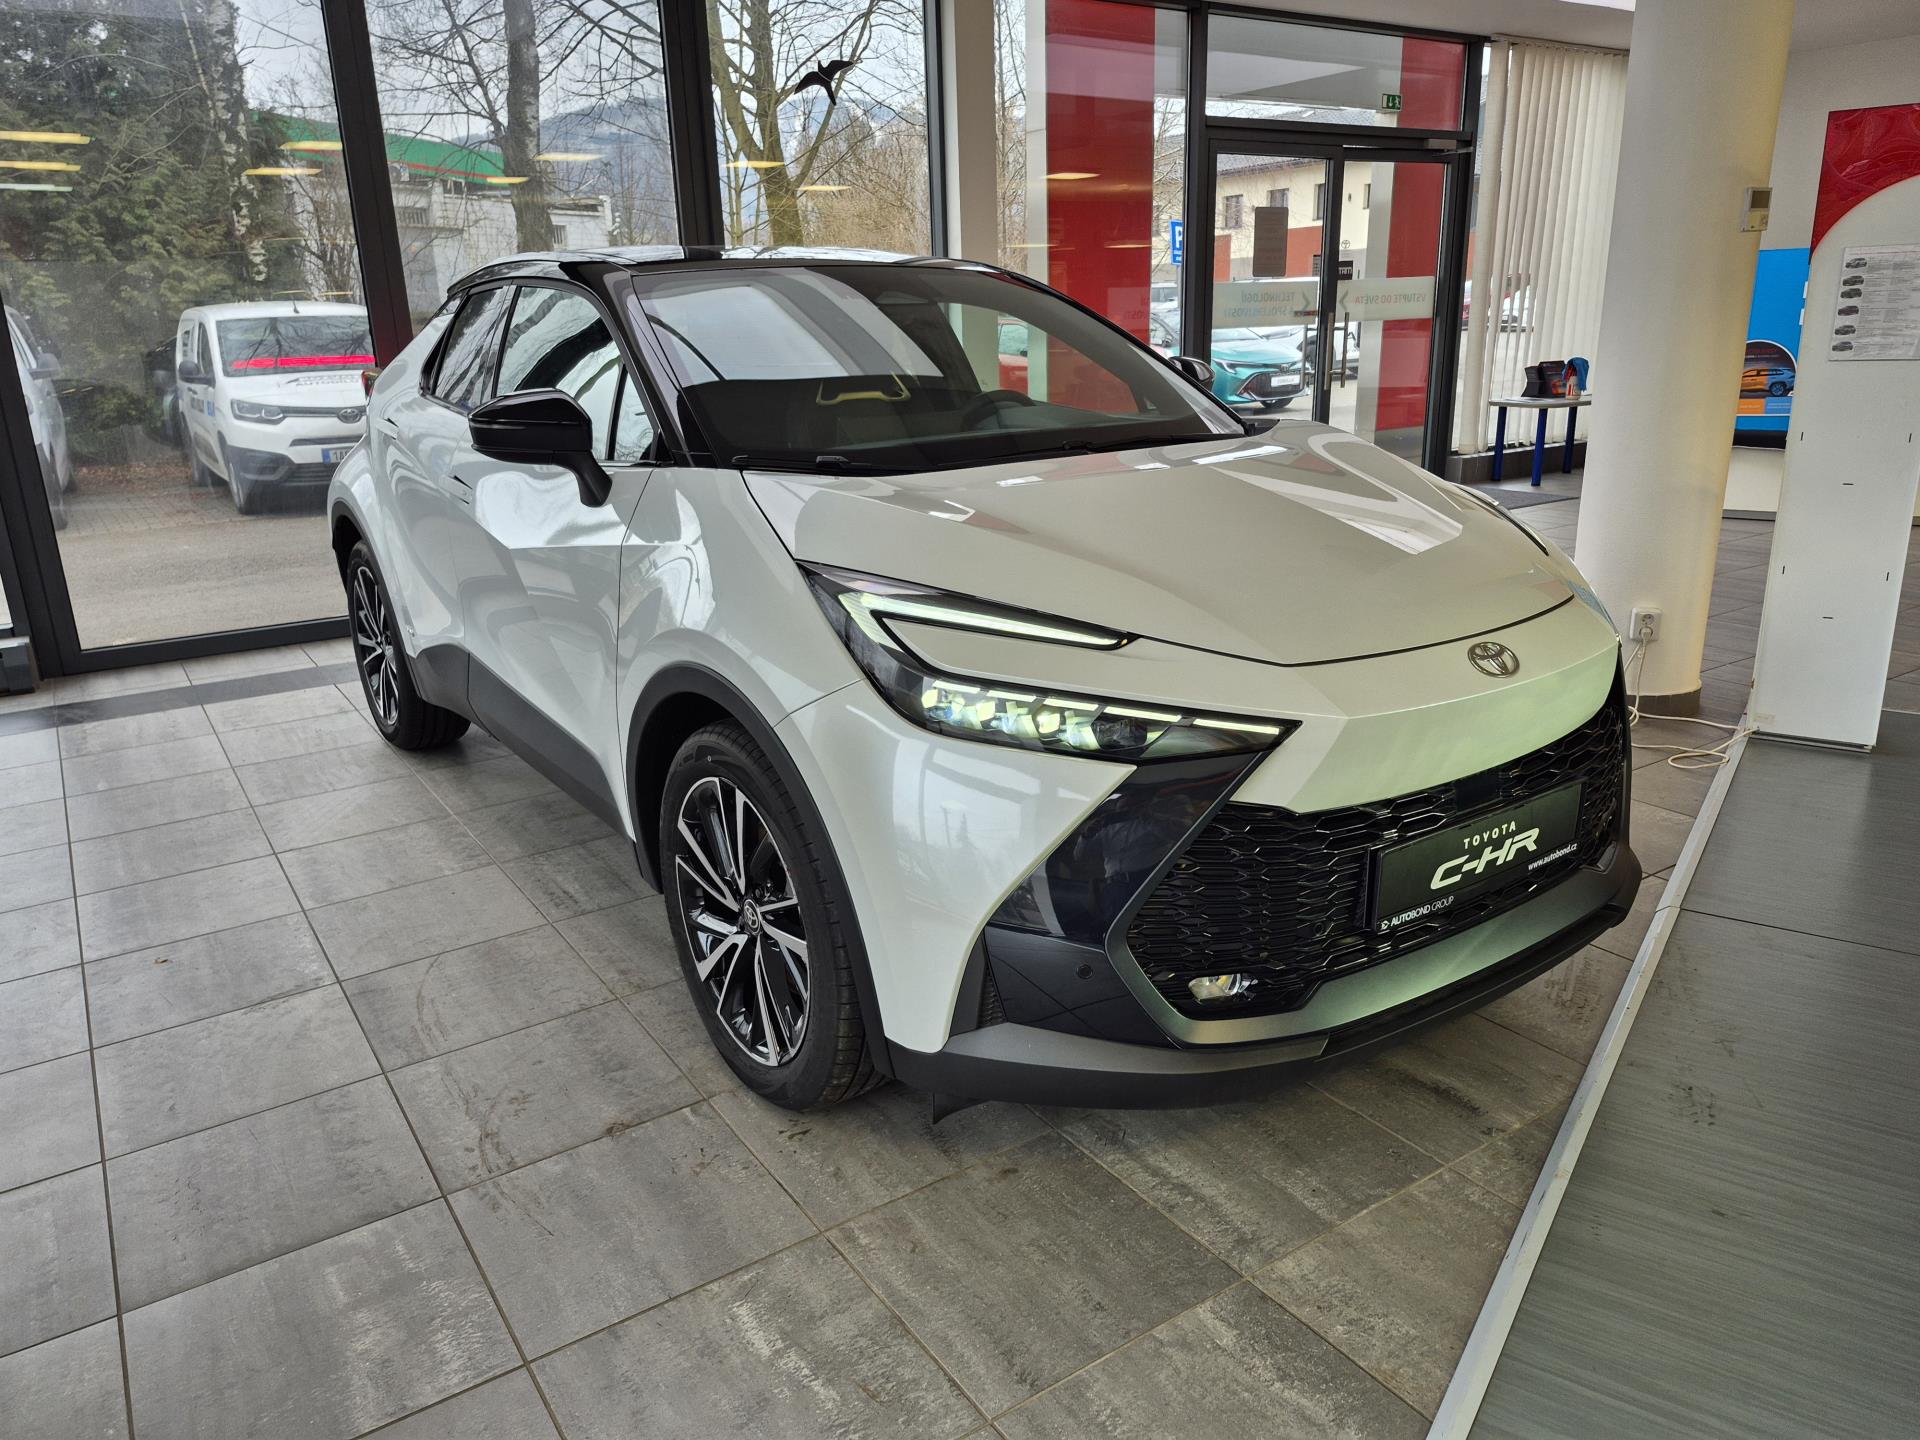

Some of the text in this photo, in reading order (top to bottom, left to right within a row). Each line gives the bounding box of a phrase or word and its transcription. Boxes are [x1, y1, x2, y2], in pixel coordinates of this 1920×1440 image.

[1175, 226, 1183, 248] P
[1463, 821, 1516, 850] TOYOTA
[1430, 827, 1540, 890] C-HR
[1528, 843, 1578, 871] www.autobond.cz
[1391, 895, 1454, 927] AUTOBOND GROUP
